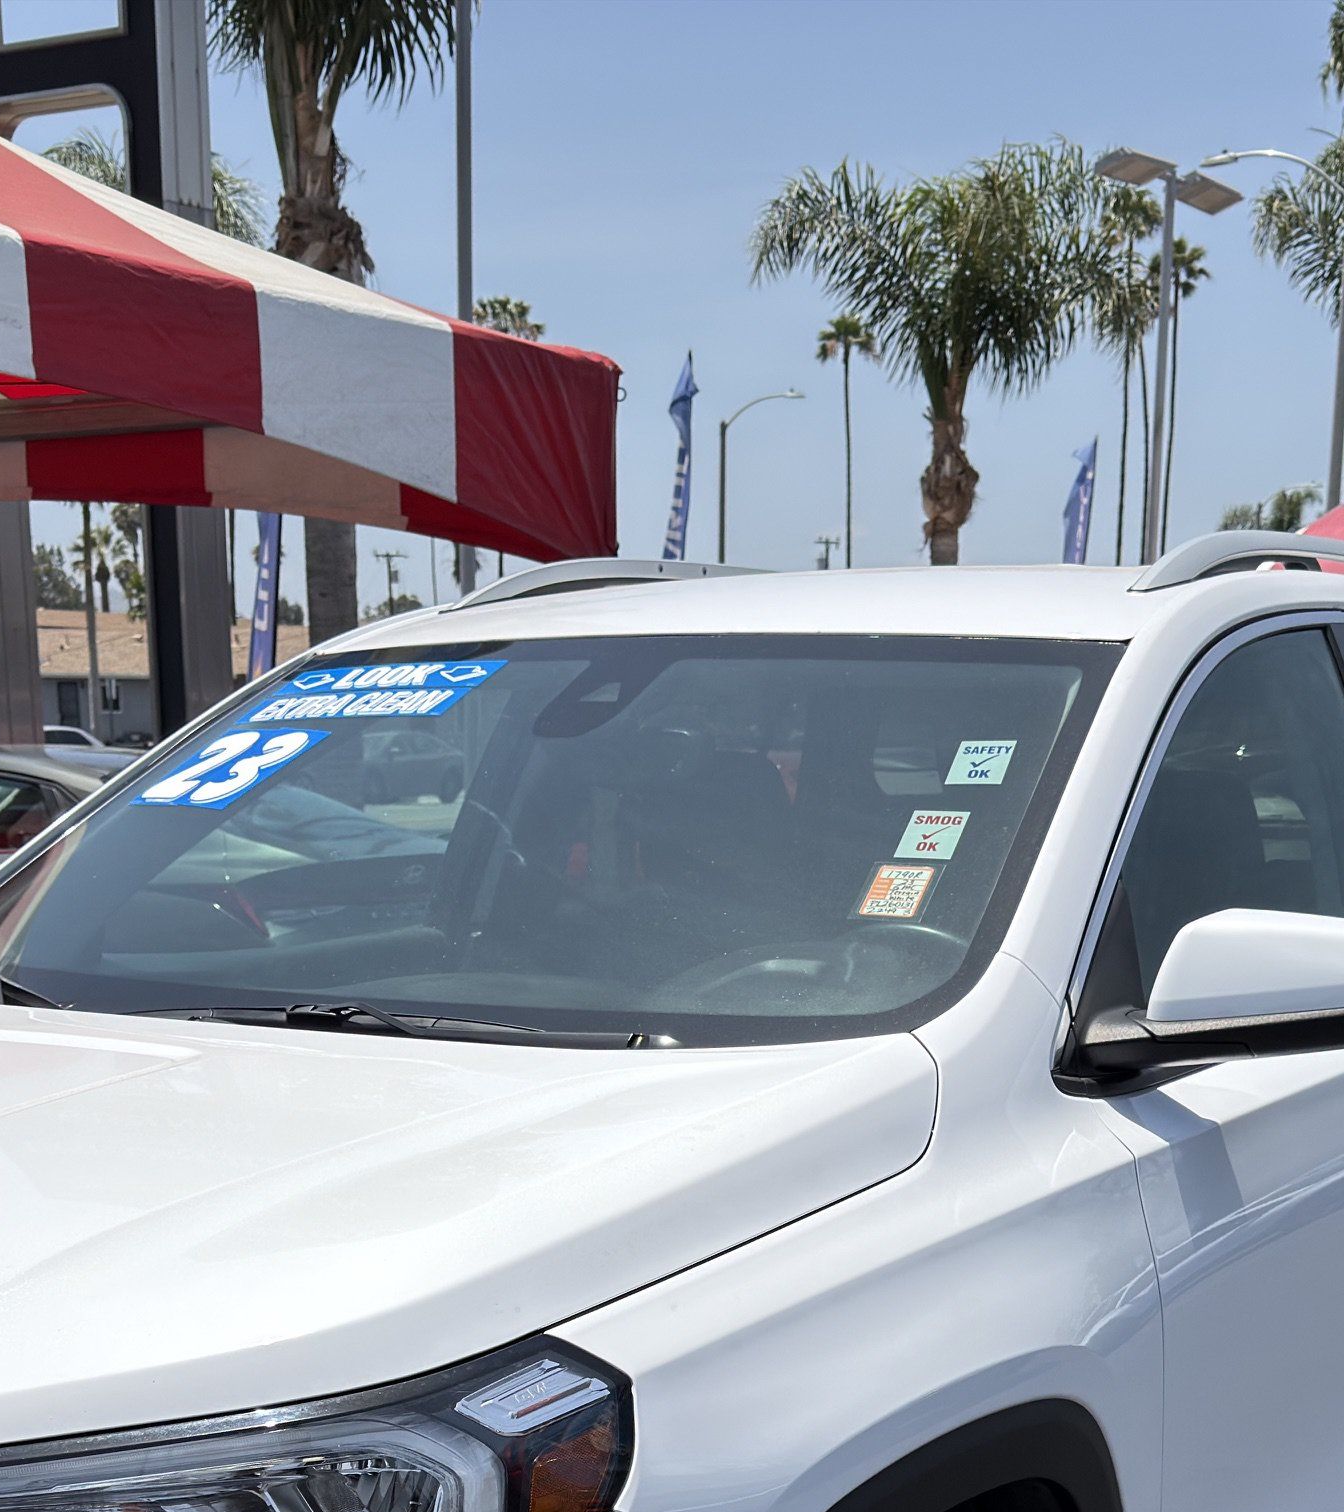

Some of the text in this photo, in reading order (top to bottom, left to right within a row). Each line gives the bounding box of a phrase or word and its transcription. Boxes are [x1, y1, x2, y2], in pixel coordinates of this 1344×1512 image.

[331, 664, 445, 690] LOOK
[250, 690, 454, 722] EXTRA CLEAN
[962, 745, 1013, 755] SAFETY
[141, 731, 309, 804] 23
[967, 769, 991, 779] OK
[914, 815, 964, 826] SMOG
[916, 841, 940, 852] OK
